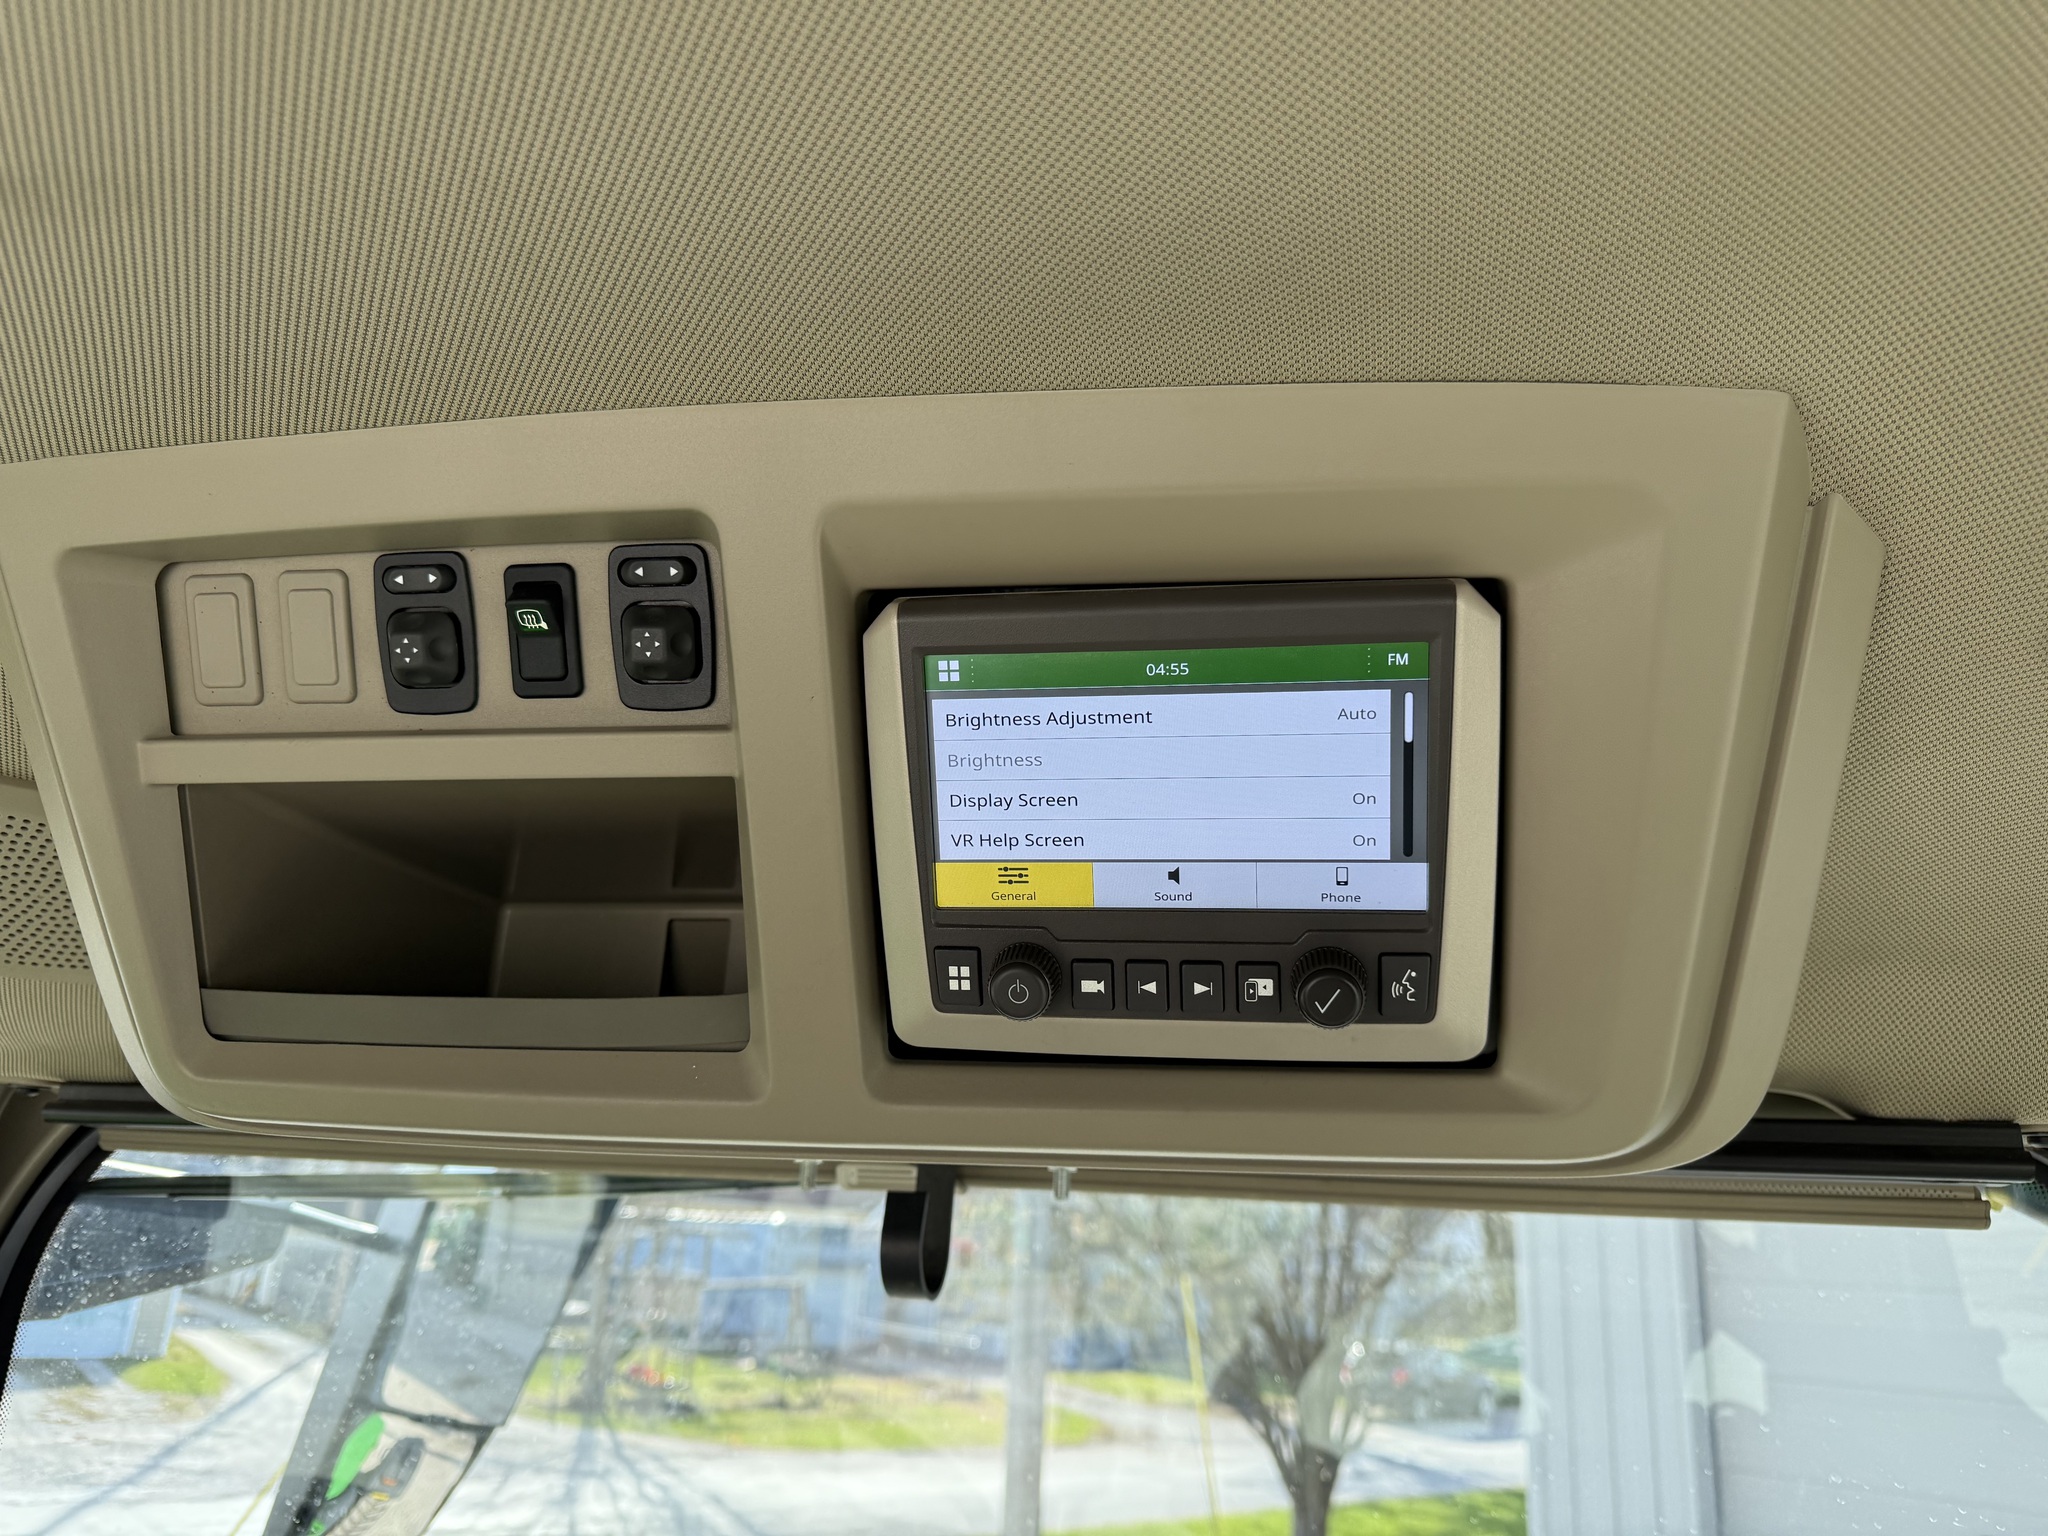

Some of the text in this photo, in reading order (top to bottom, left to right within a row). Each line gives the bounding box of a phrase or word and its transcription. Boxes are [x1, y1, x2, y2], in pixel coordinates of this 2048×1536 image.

[1387, 653, 1410, 667] FM
[1145, 662, 1190, 677] 04:55
[945, 708, 1153, 731] Brightness Adjustment
[1337, 706, 1377, 721] Auto
[946, 751, 1043, 772] Brightness
[949, 792, 1079, 812] Display Screen
[1352, 792, 1377, 805] On
[950, 832, 1085, 851] VR Help Screen
[1352, 834, 1377, 847] On
[990, 890, 1037, 902] General
[1153, 890, 1193, 902] Sound
[1320, 891, 1362, 903] Phone
